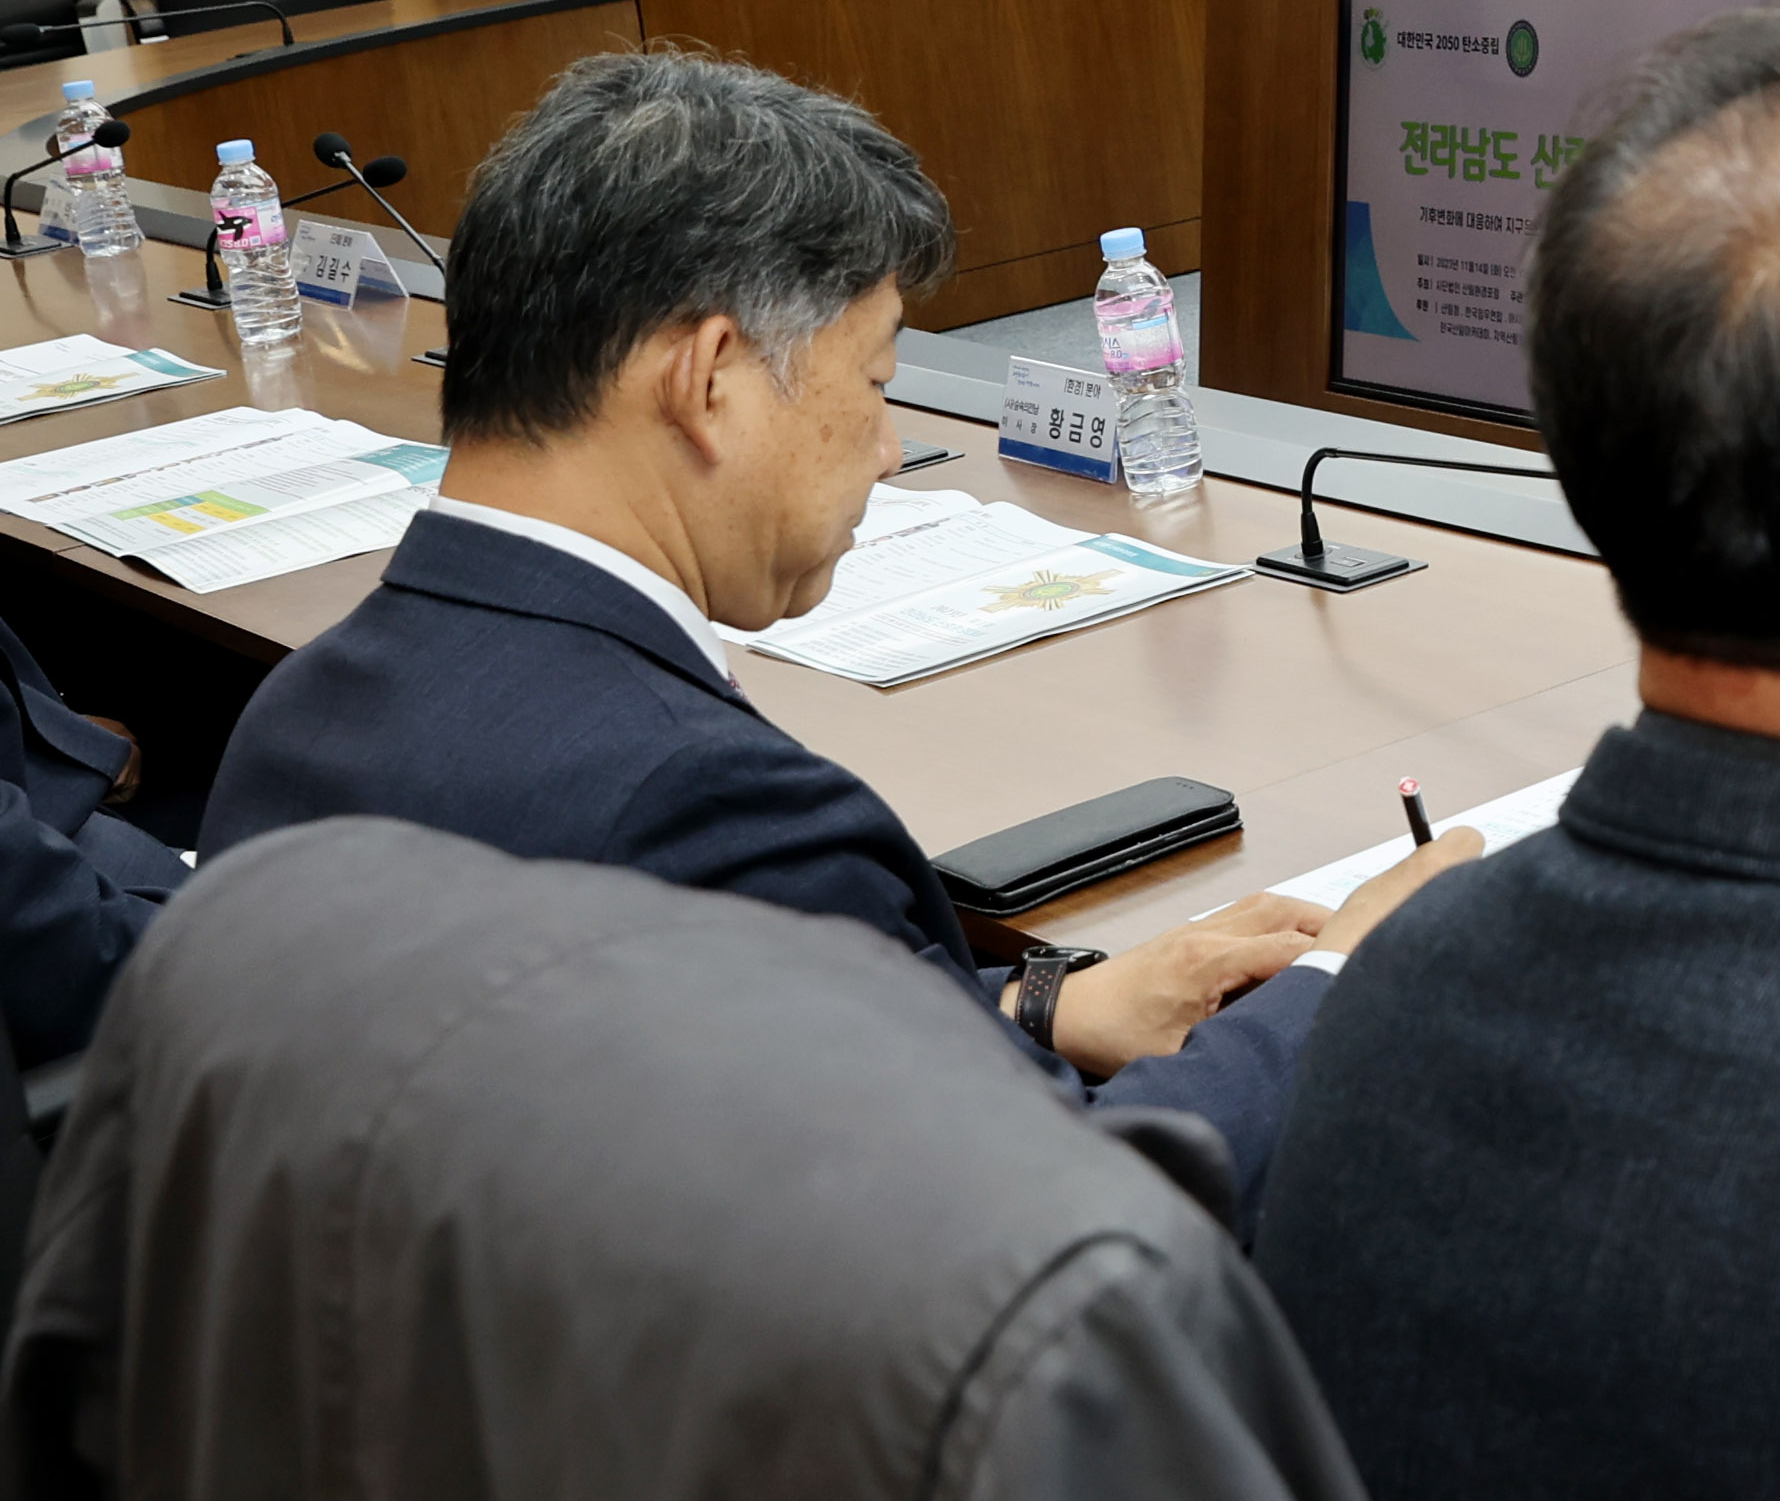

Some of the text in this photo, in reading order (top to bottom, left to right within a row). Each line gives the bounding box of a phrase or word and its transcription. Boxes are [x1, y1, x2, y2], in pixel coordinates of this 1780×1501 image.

[1396, 30, 1433, 50] 대한민국
[1435, 34, 1459, 52] 2050
[1399, 120, 1522, 188] 전라남도
